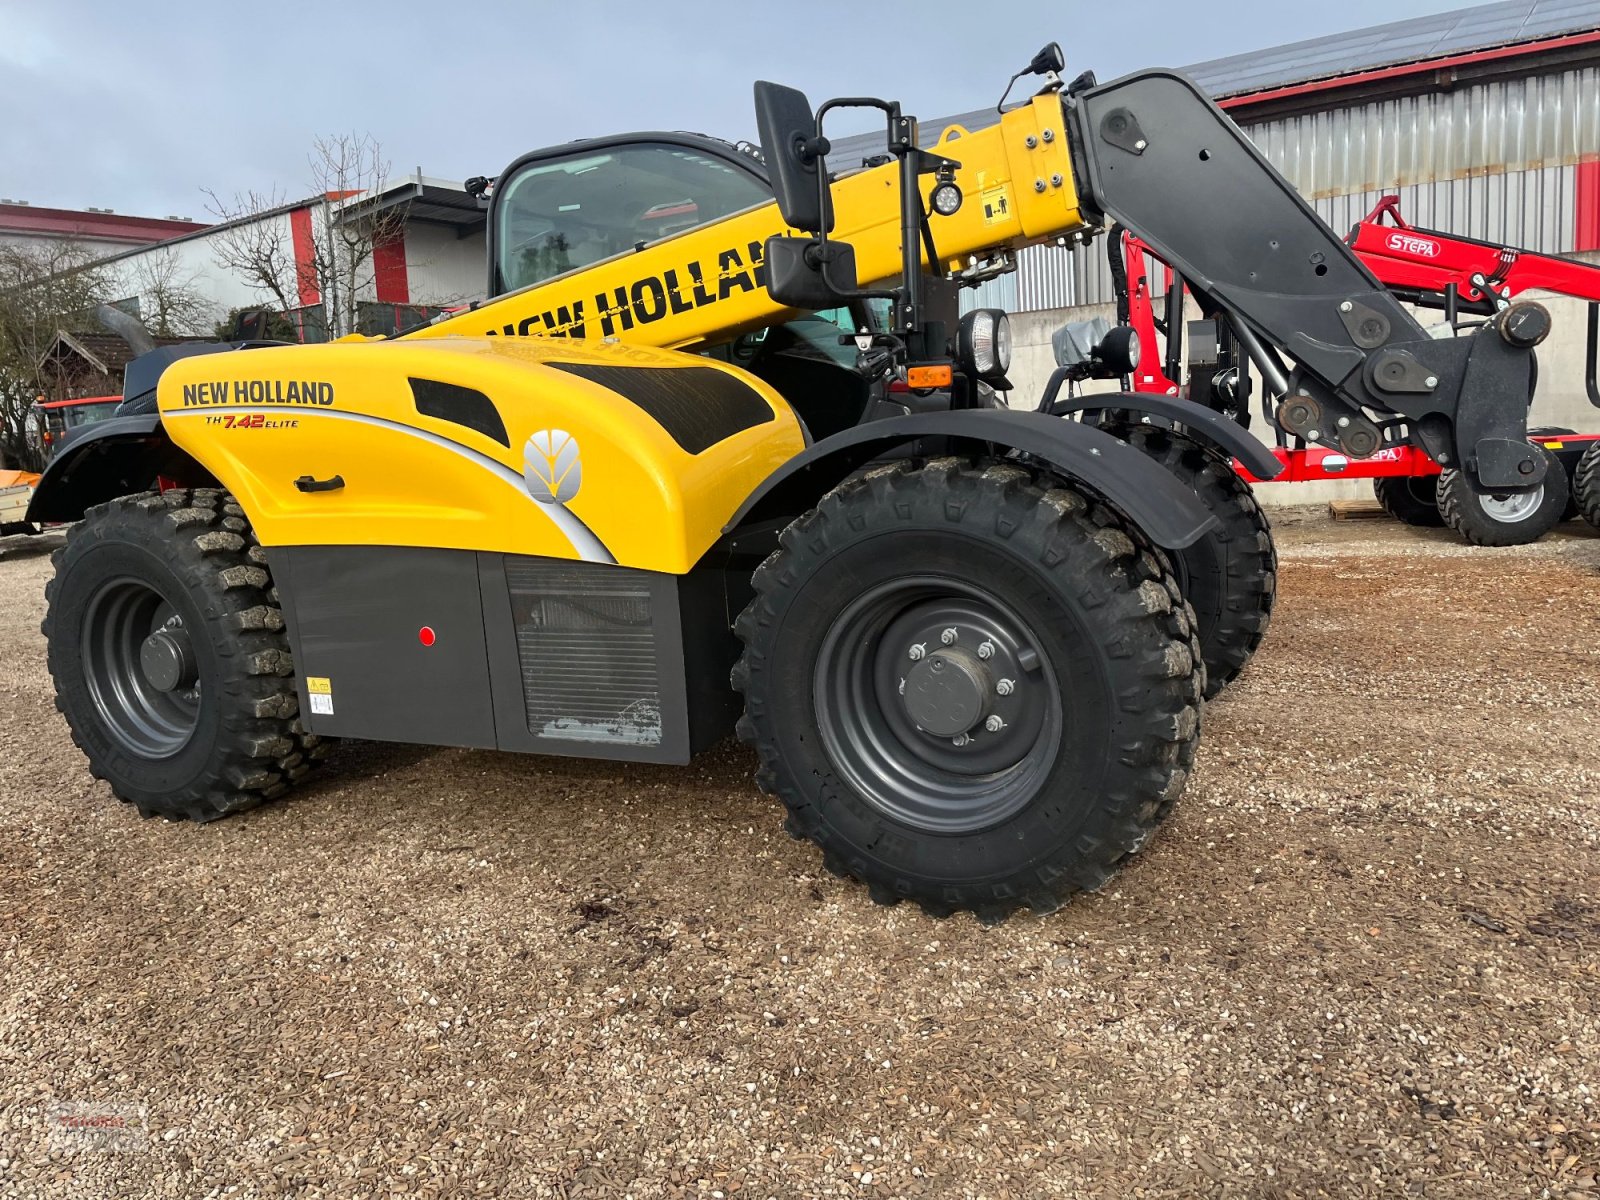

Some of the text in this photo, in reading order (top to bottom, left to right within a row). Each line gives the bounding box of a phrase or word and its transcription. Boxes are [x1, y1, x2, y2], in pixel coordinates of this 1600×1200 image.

[1389, 234, 1434, 256] STEPA
[595, 231, 791, 337] HOLLA
[183, 380, 334, 406] NEW HOLLAND
[223, 414, 265, 429] 7.42
[265, 420, 299, 428] ELITE
